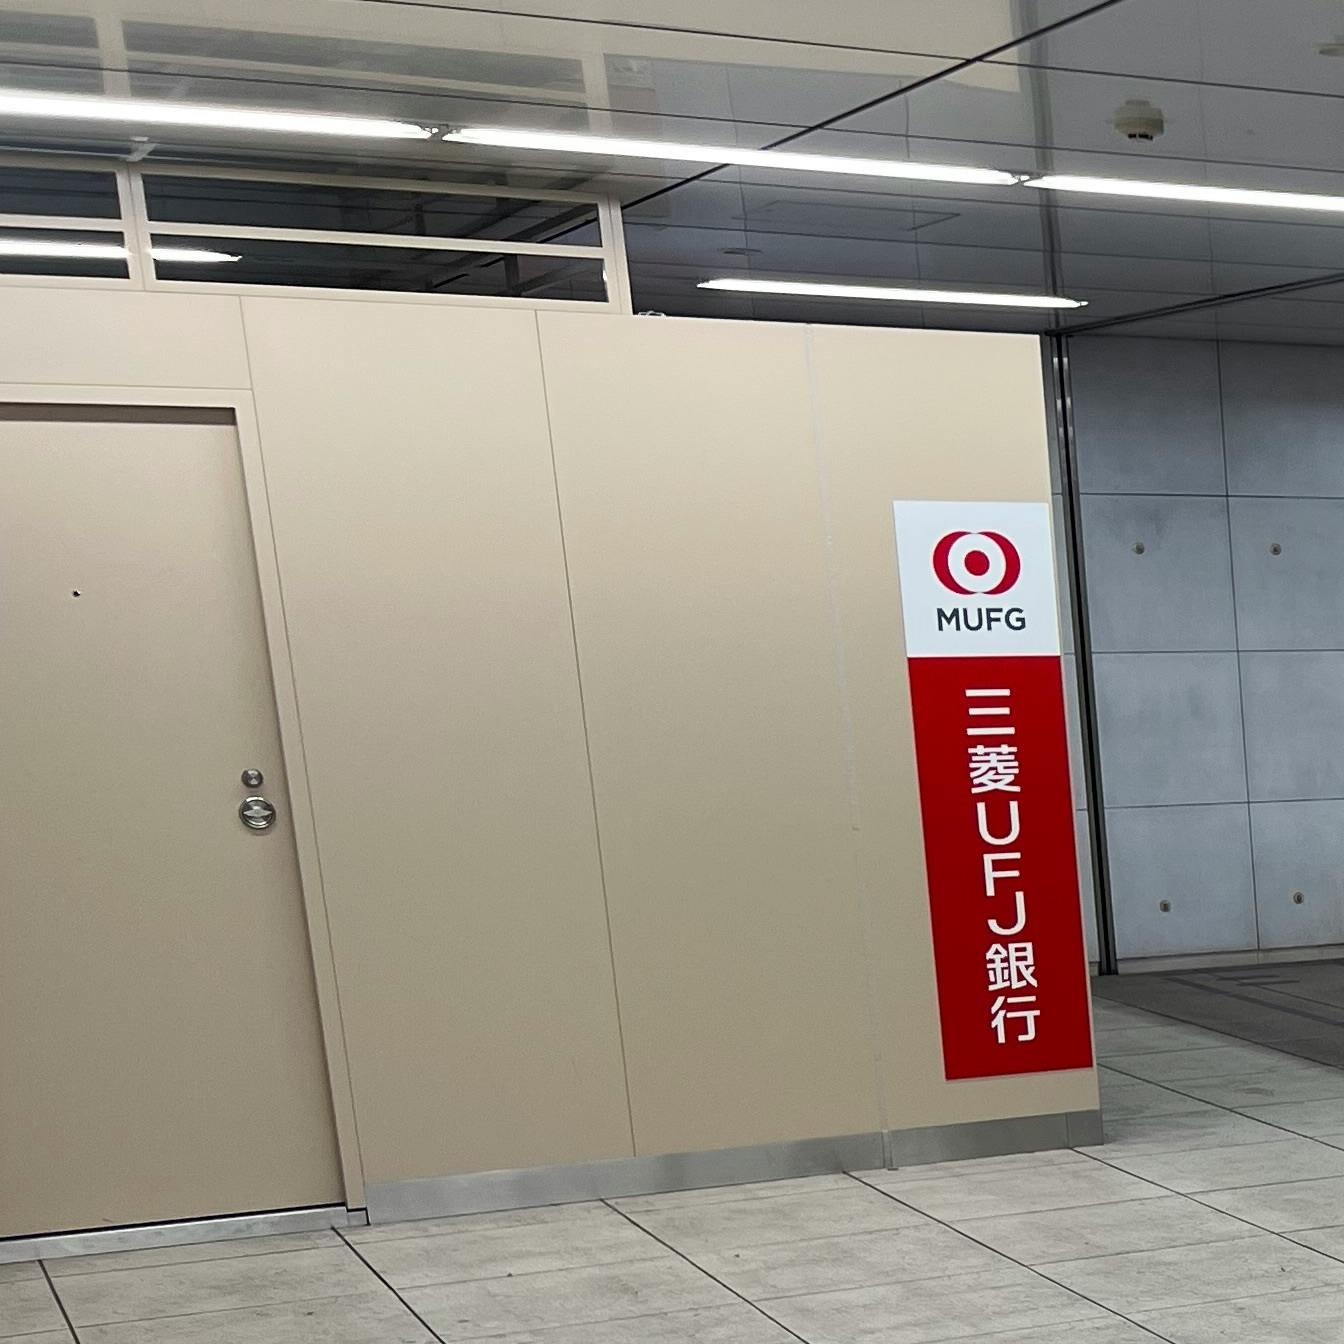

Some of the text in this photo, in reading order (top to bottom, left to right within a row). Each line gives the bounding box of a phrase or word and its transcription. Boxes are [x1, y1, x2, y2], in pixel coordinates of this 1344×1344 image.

[936, 607, 1026, 631] MUFG
[964, 687, 1041, 1044] 三菱UFJ銀行
